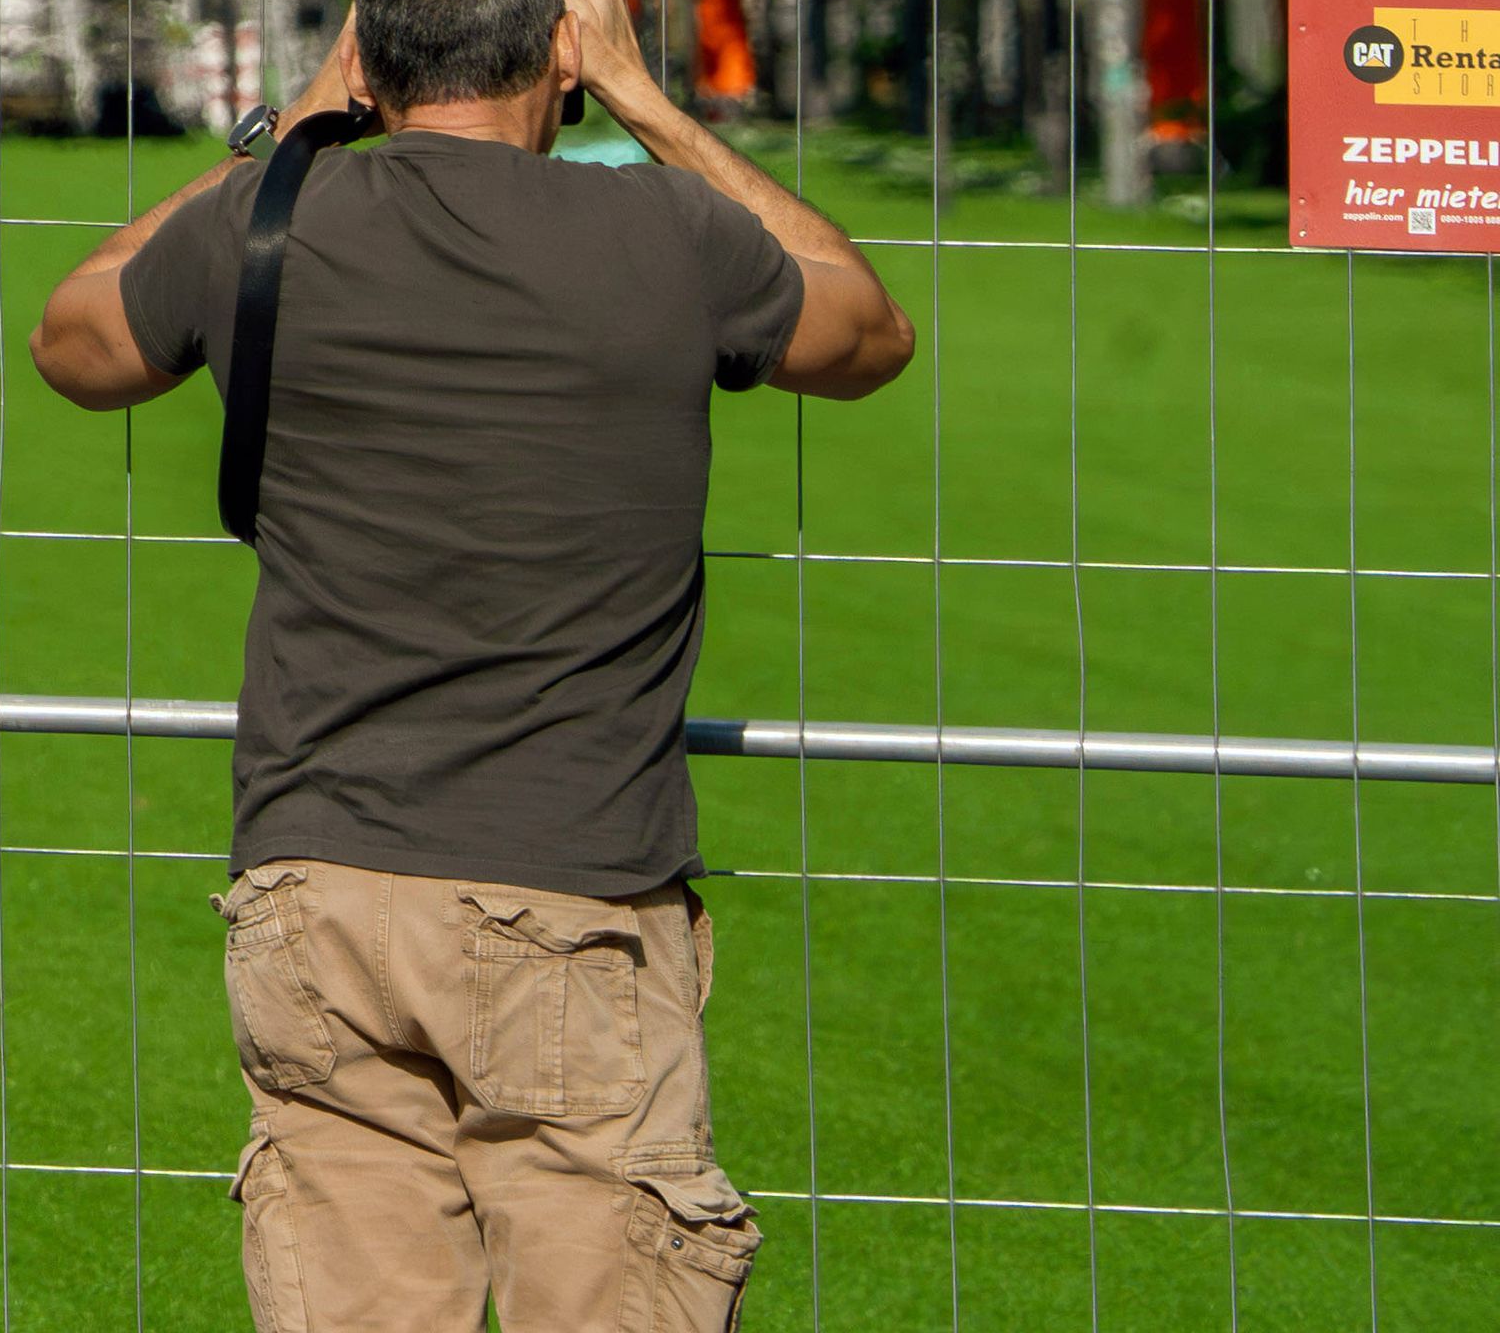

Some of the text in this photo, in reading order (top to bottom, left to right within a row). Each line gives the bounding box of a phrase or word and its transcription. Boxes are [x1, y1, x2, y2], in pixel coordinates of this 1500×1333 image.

[1352, 41, 1394, 68] CAT
[1344, 179, 1500, 209] hier miete
